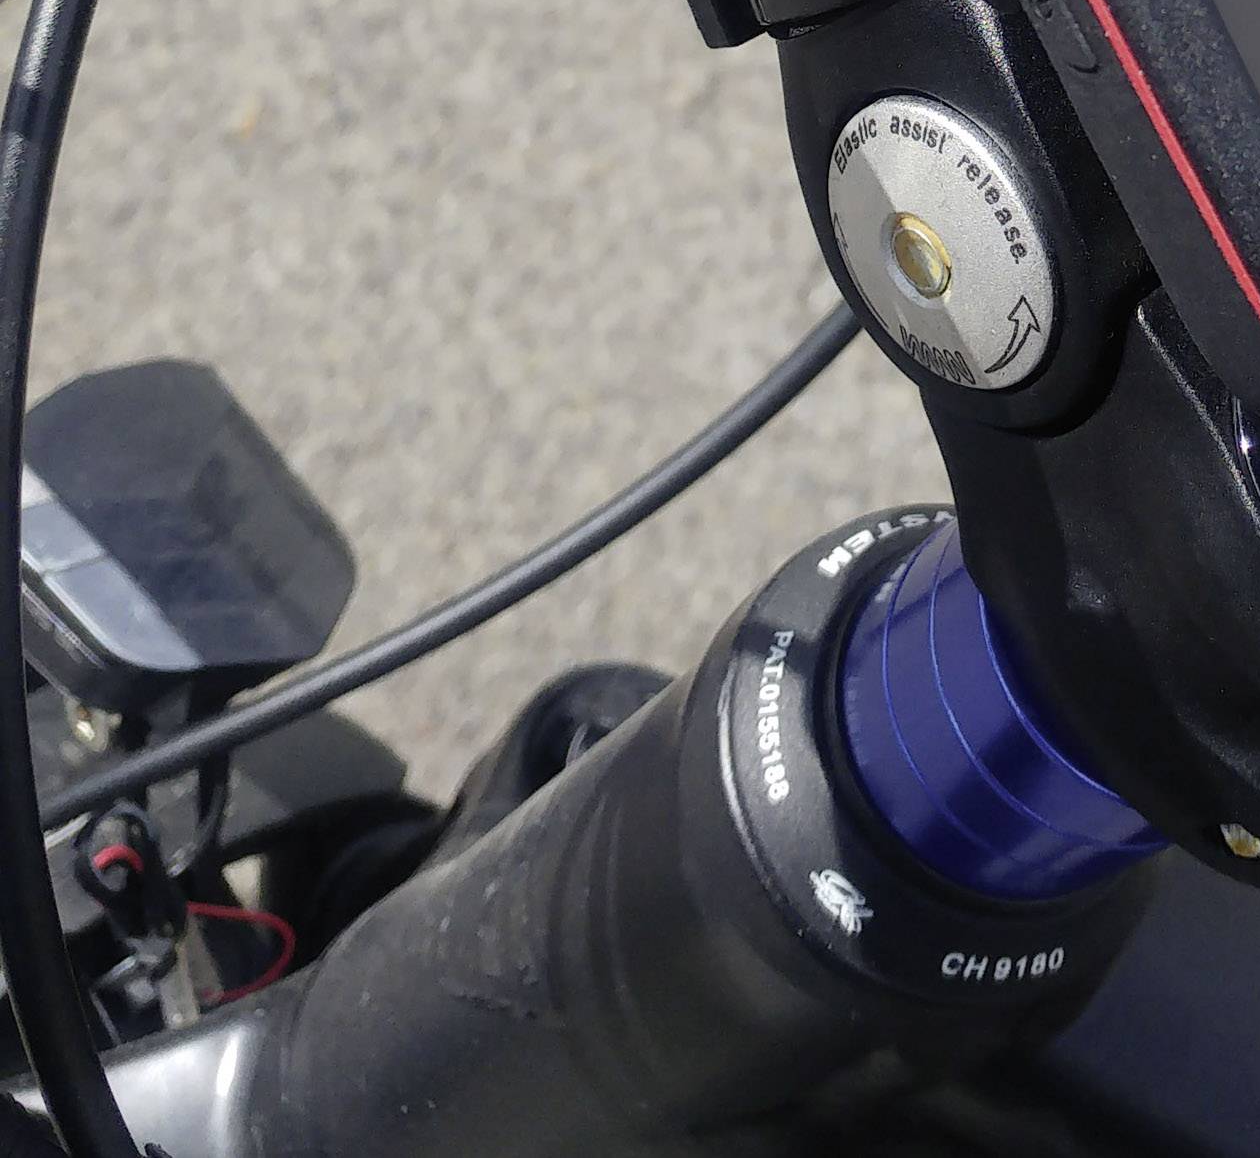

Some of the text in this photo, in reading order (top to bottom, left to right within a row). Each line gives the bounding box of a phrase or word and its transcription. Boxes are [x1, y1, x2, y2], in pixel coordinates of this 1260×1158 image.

[833, 114, 1028, 265] Elastic assist release.
[817, 511, 955, 578] YSTEM
[757, 630, 794, 803] PAT.0155188
[941, 952, 989, 981] CH
